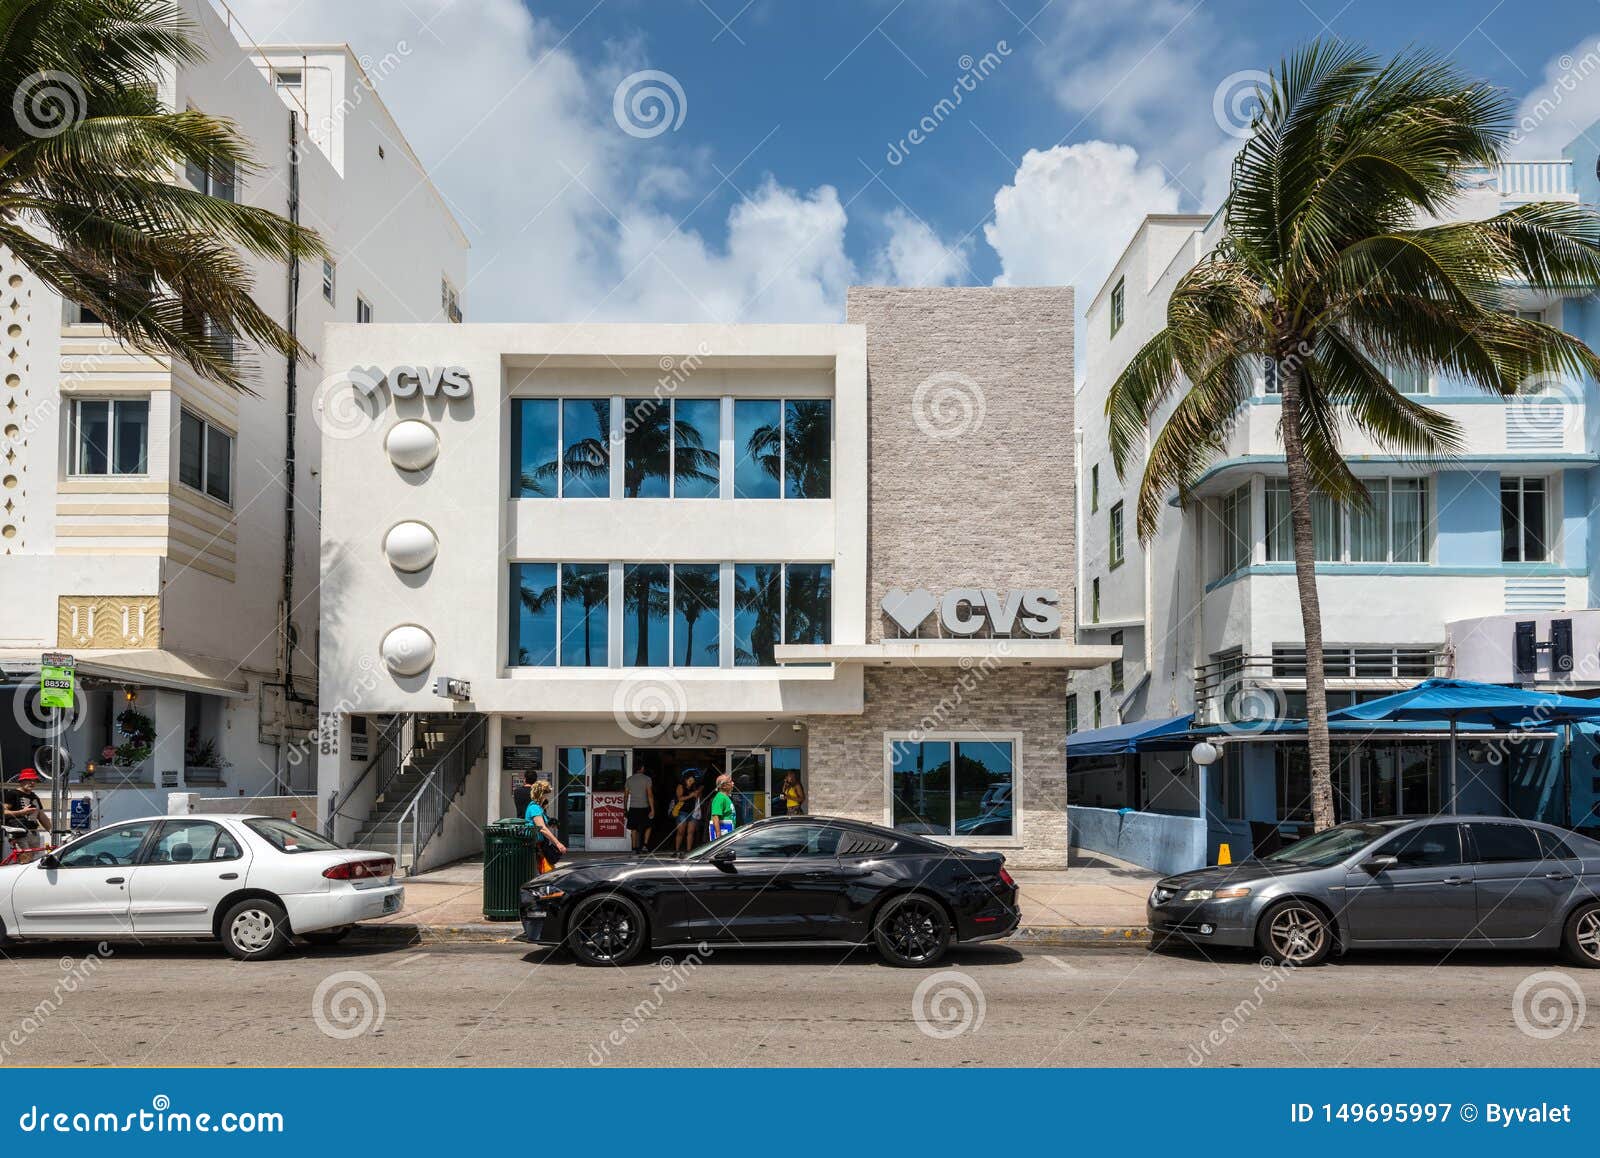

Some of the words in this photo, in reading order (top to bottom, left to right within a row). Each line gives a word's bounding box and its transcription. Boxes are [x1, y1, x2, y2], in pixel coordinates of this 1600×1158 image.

[388, 366, 471, 397] CVS
[941, 588, 1061, 634] CVS
[44, 680, 70, 689] 88526
[668, 722, 718, 745] CVS
[604, 796, 624, 805] CVS
